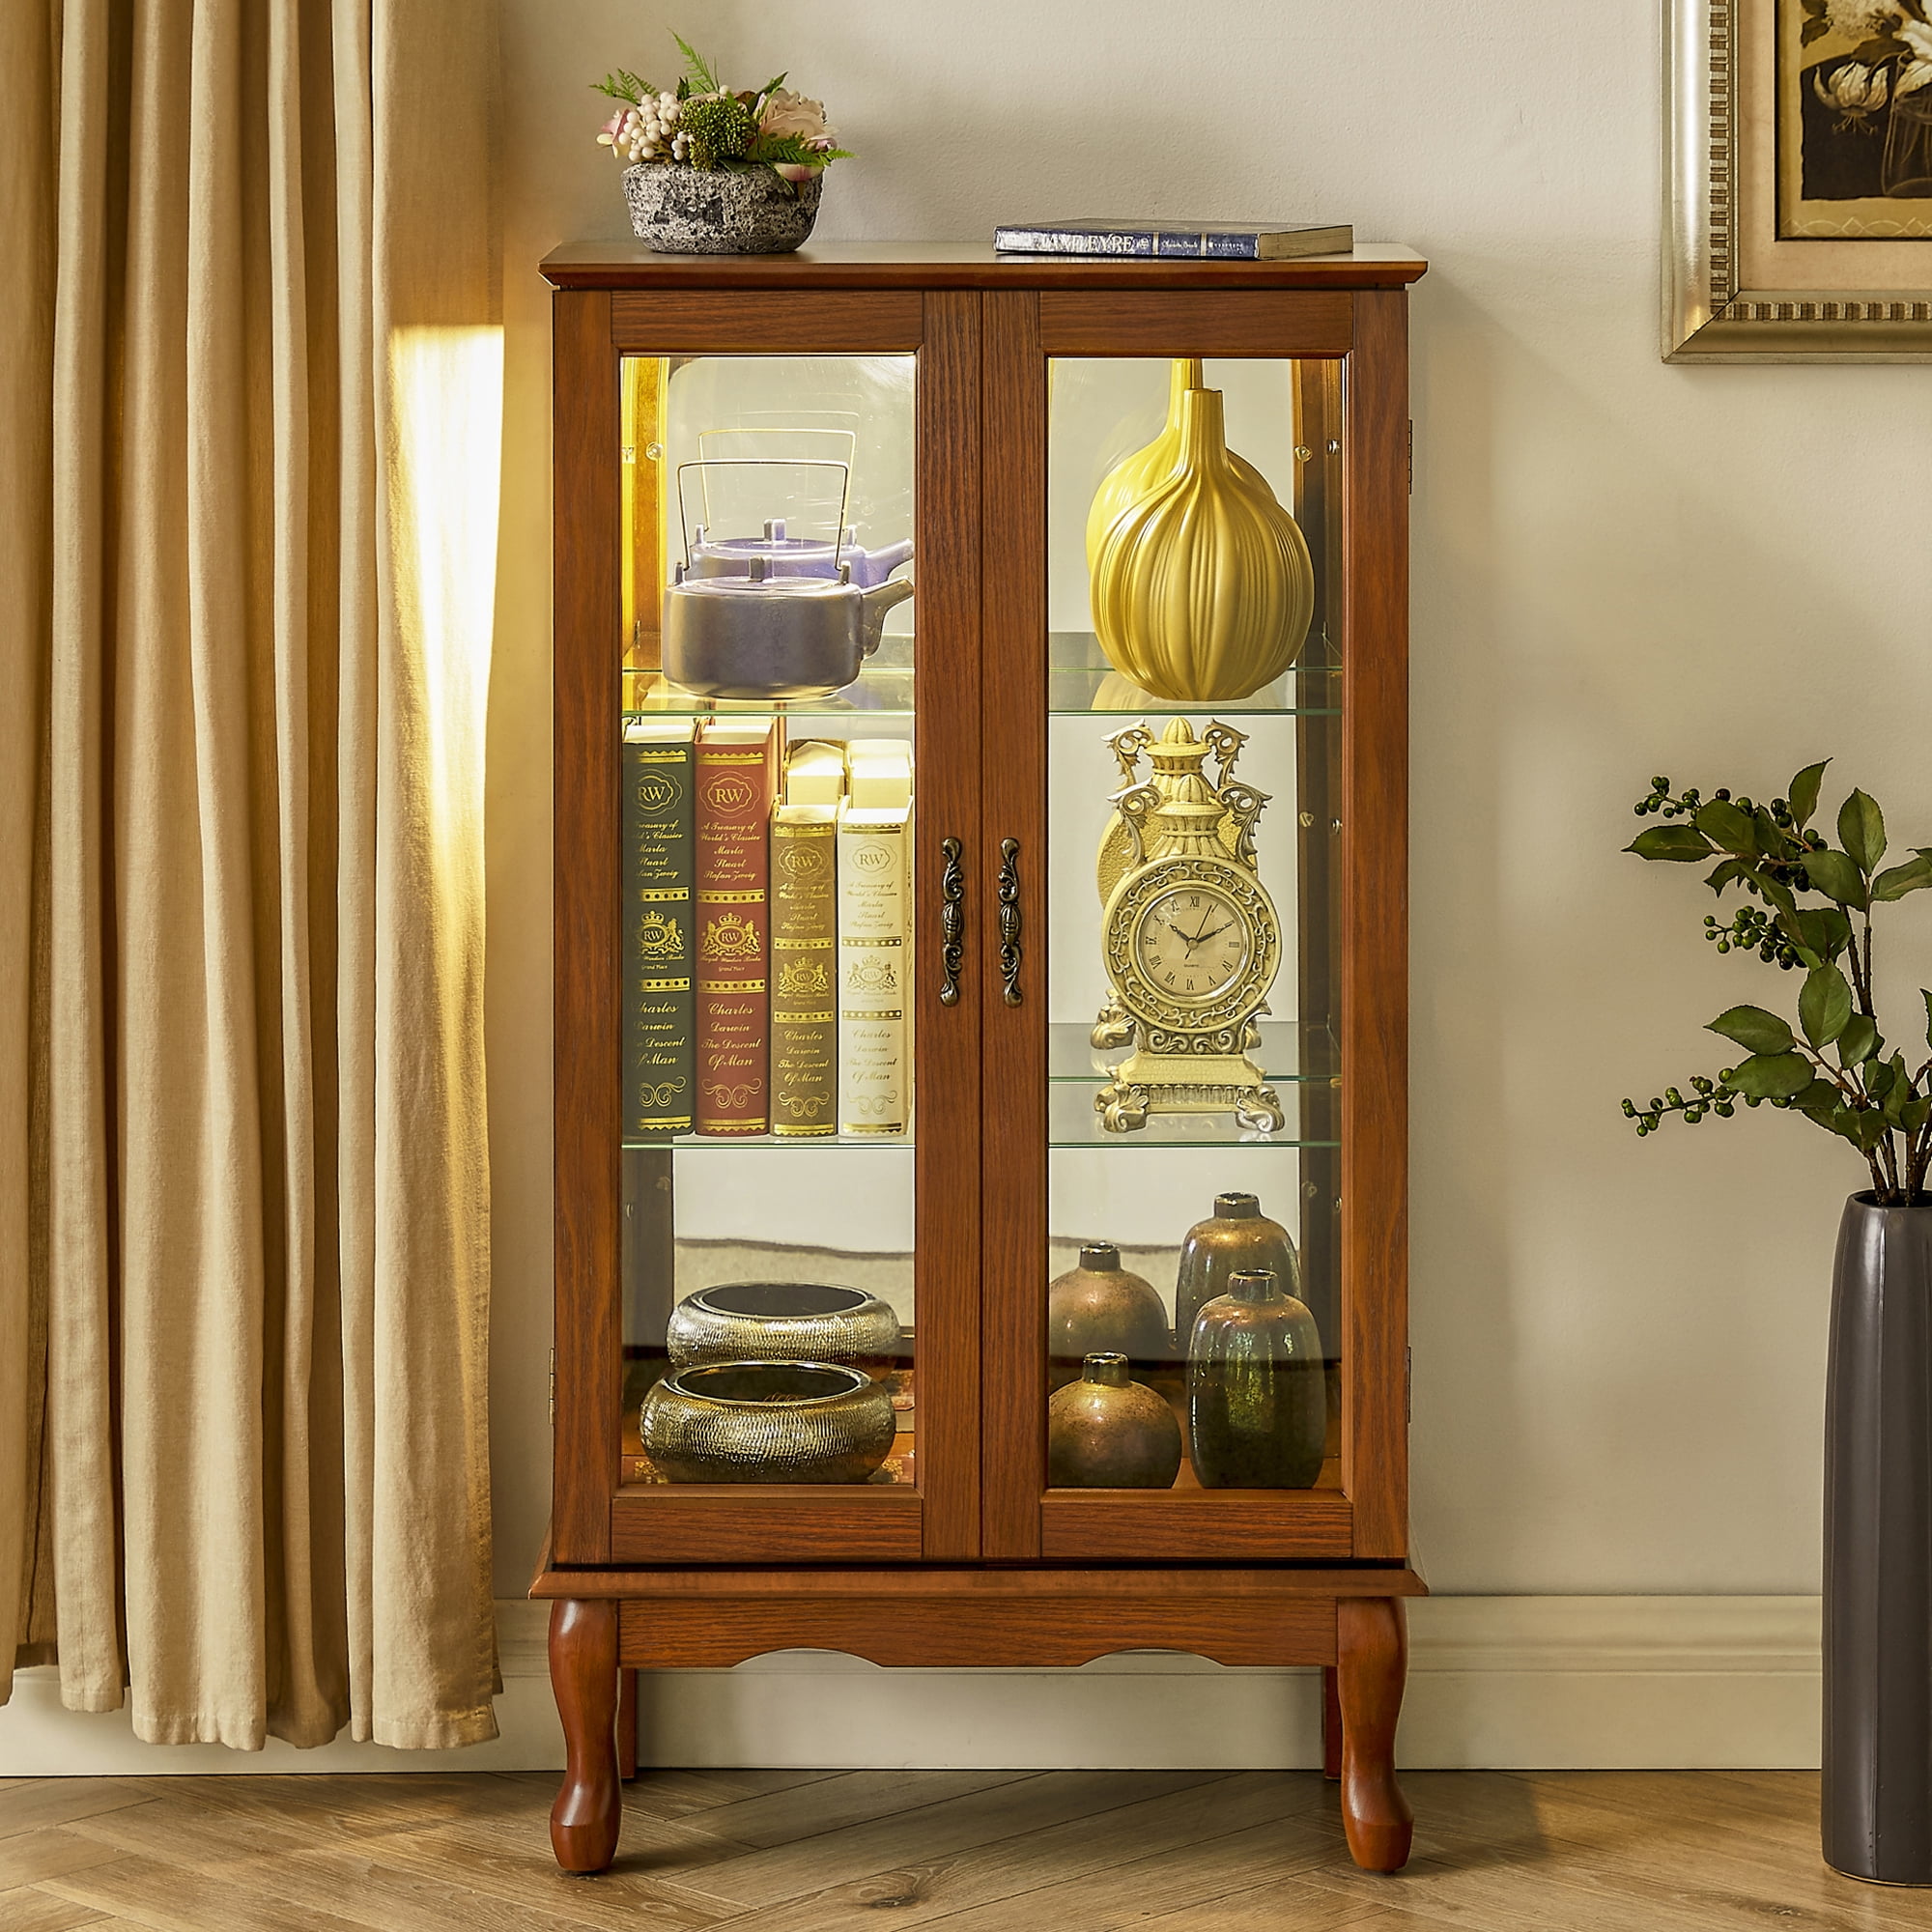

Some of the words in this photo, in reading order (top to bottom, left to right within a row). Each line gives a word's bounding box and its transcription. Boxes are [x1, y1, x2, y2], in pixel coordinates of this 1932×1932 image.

[1088, 235, 1134, 254] EYRE
[639, 786, 666, 802] RW
[715, 788, 744, 804] RW
[669, 819, 679, 831] of
[710, 822, 746, 833] Treasury
[747, 821, 757, 833] of
[700, 833, 729, 841] World's
[790, 855, 816, 868] RW
[859, 853, 883, 866] RW
[1190, 896, 1200, 907] XII
[643, 930, 662, 941] RW
[721, 932, 740, 943] RW
[796, 973, 810, 981] RW
[639, 1001, 679, 1013] harles
[708, 1002, 755, 1015] Charles
[710, 1021, 752, 1032] Darwin
[783, 1029, 823, 1041] Charles
[852, 1029, 891, 1038] Charles
[645, 1037, 686, 1048] Descent
[701, 1037, 720, 1049] The
[723, 1037, 762, 1049] Descent
[786, 1046, 820, 1055] Darwin
[646, 1052, 679, 1065] Man
[708, 1054, 725, 1071] Of
[724, 1054, 755, 1066] Man
[778, 1059, 795, 1068] The
[797, 1059, 830, 1068] Descent
[797, 1072, 822, 1083] Man
